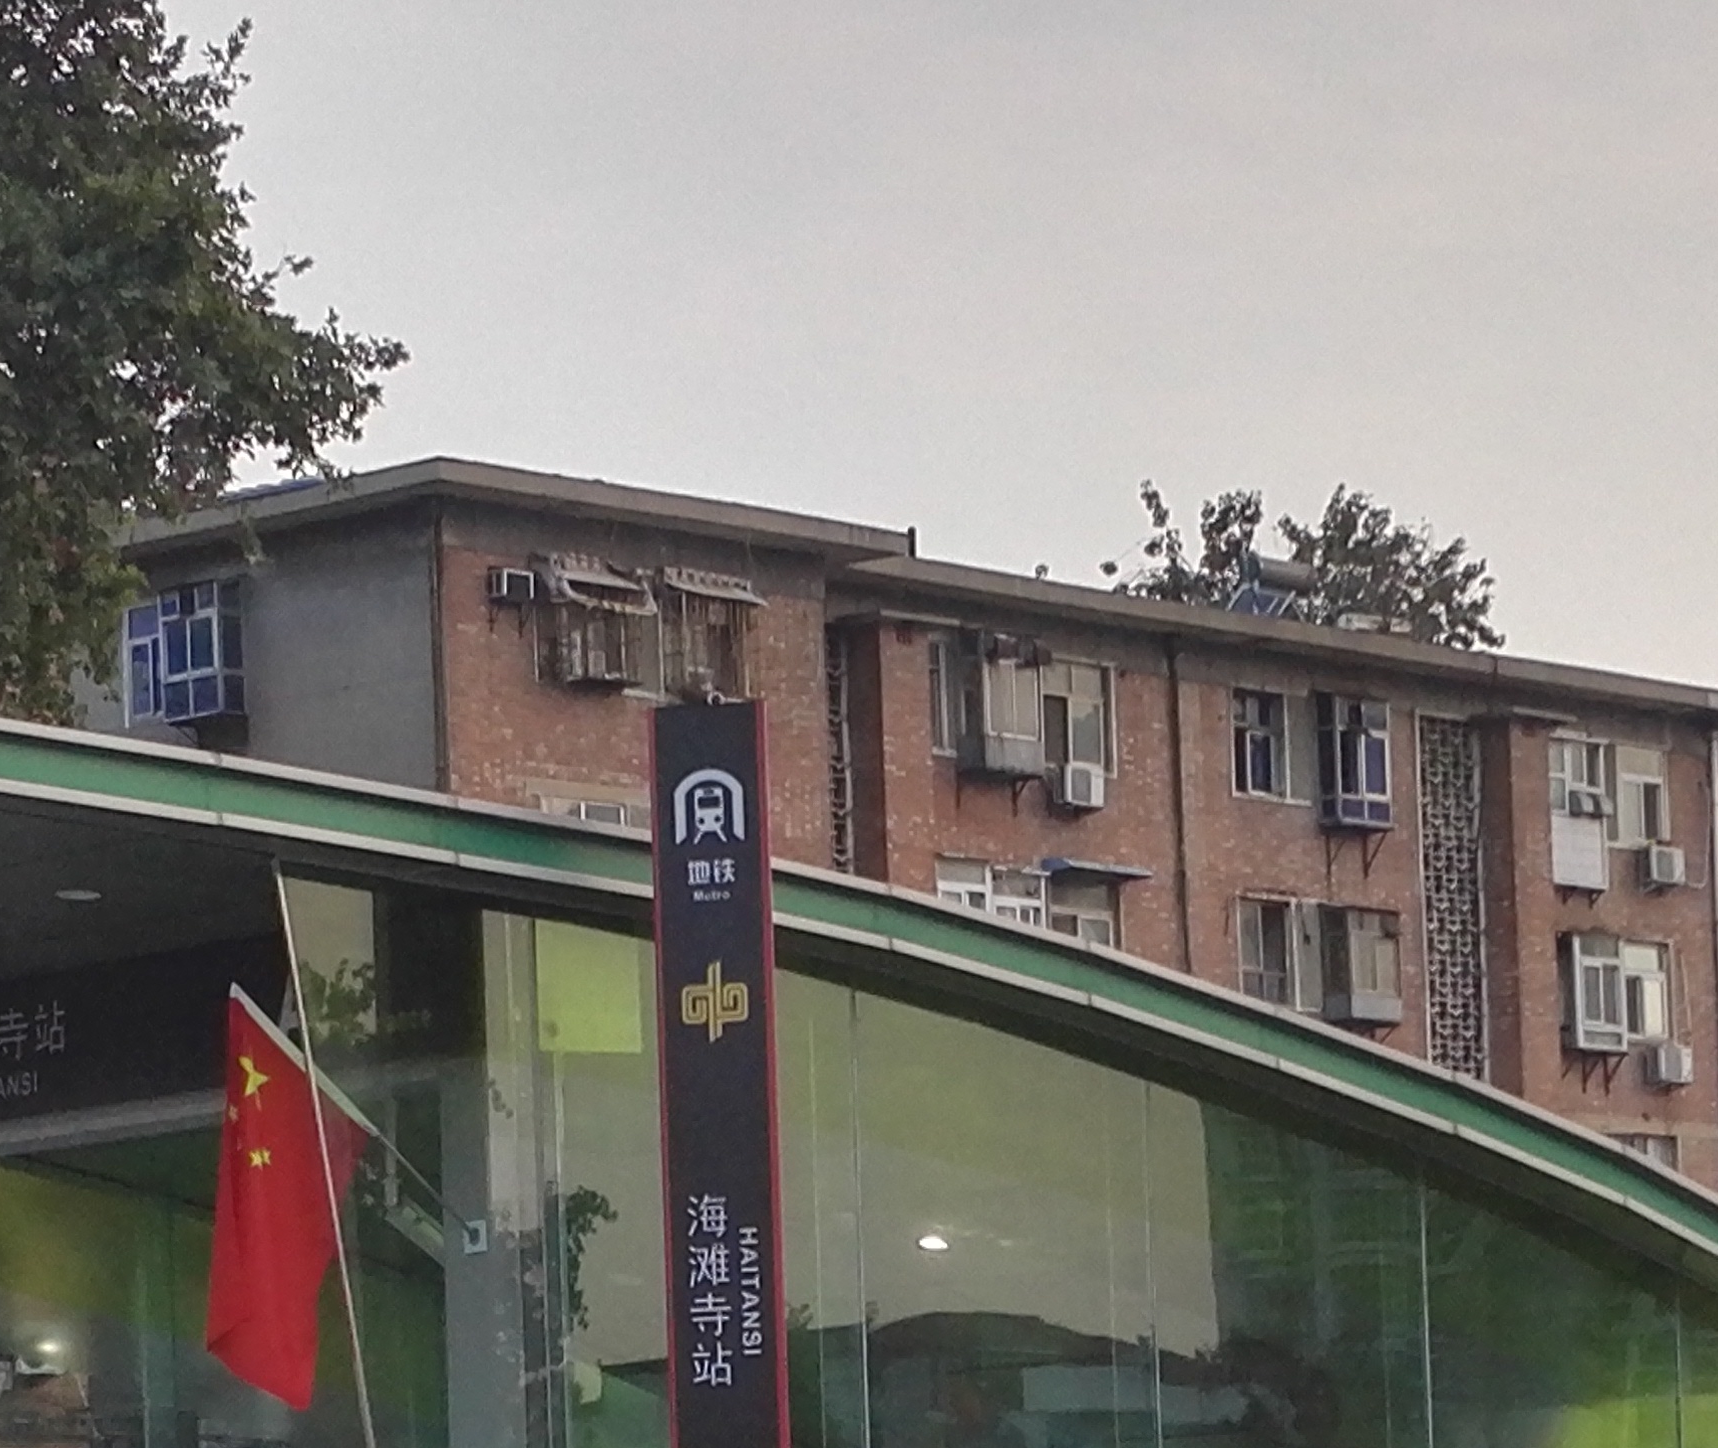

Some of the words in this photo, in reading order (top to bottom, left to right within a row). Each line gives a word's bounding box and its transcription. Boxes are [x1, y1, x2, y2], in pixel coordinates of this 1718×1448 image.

[688, 859, 736, 885] 地铁
[693, 891, 730, 901] Metro
[688, 1194, 732, 1386] 海滩寺站
[739, 1227, 763, 1356] HAITANSI
